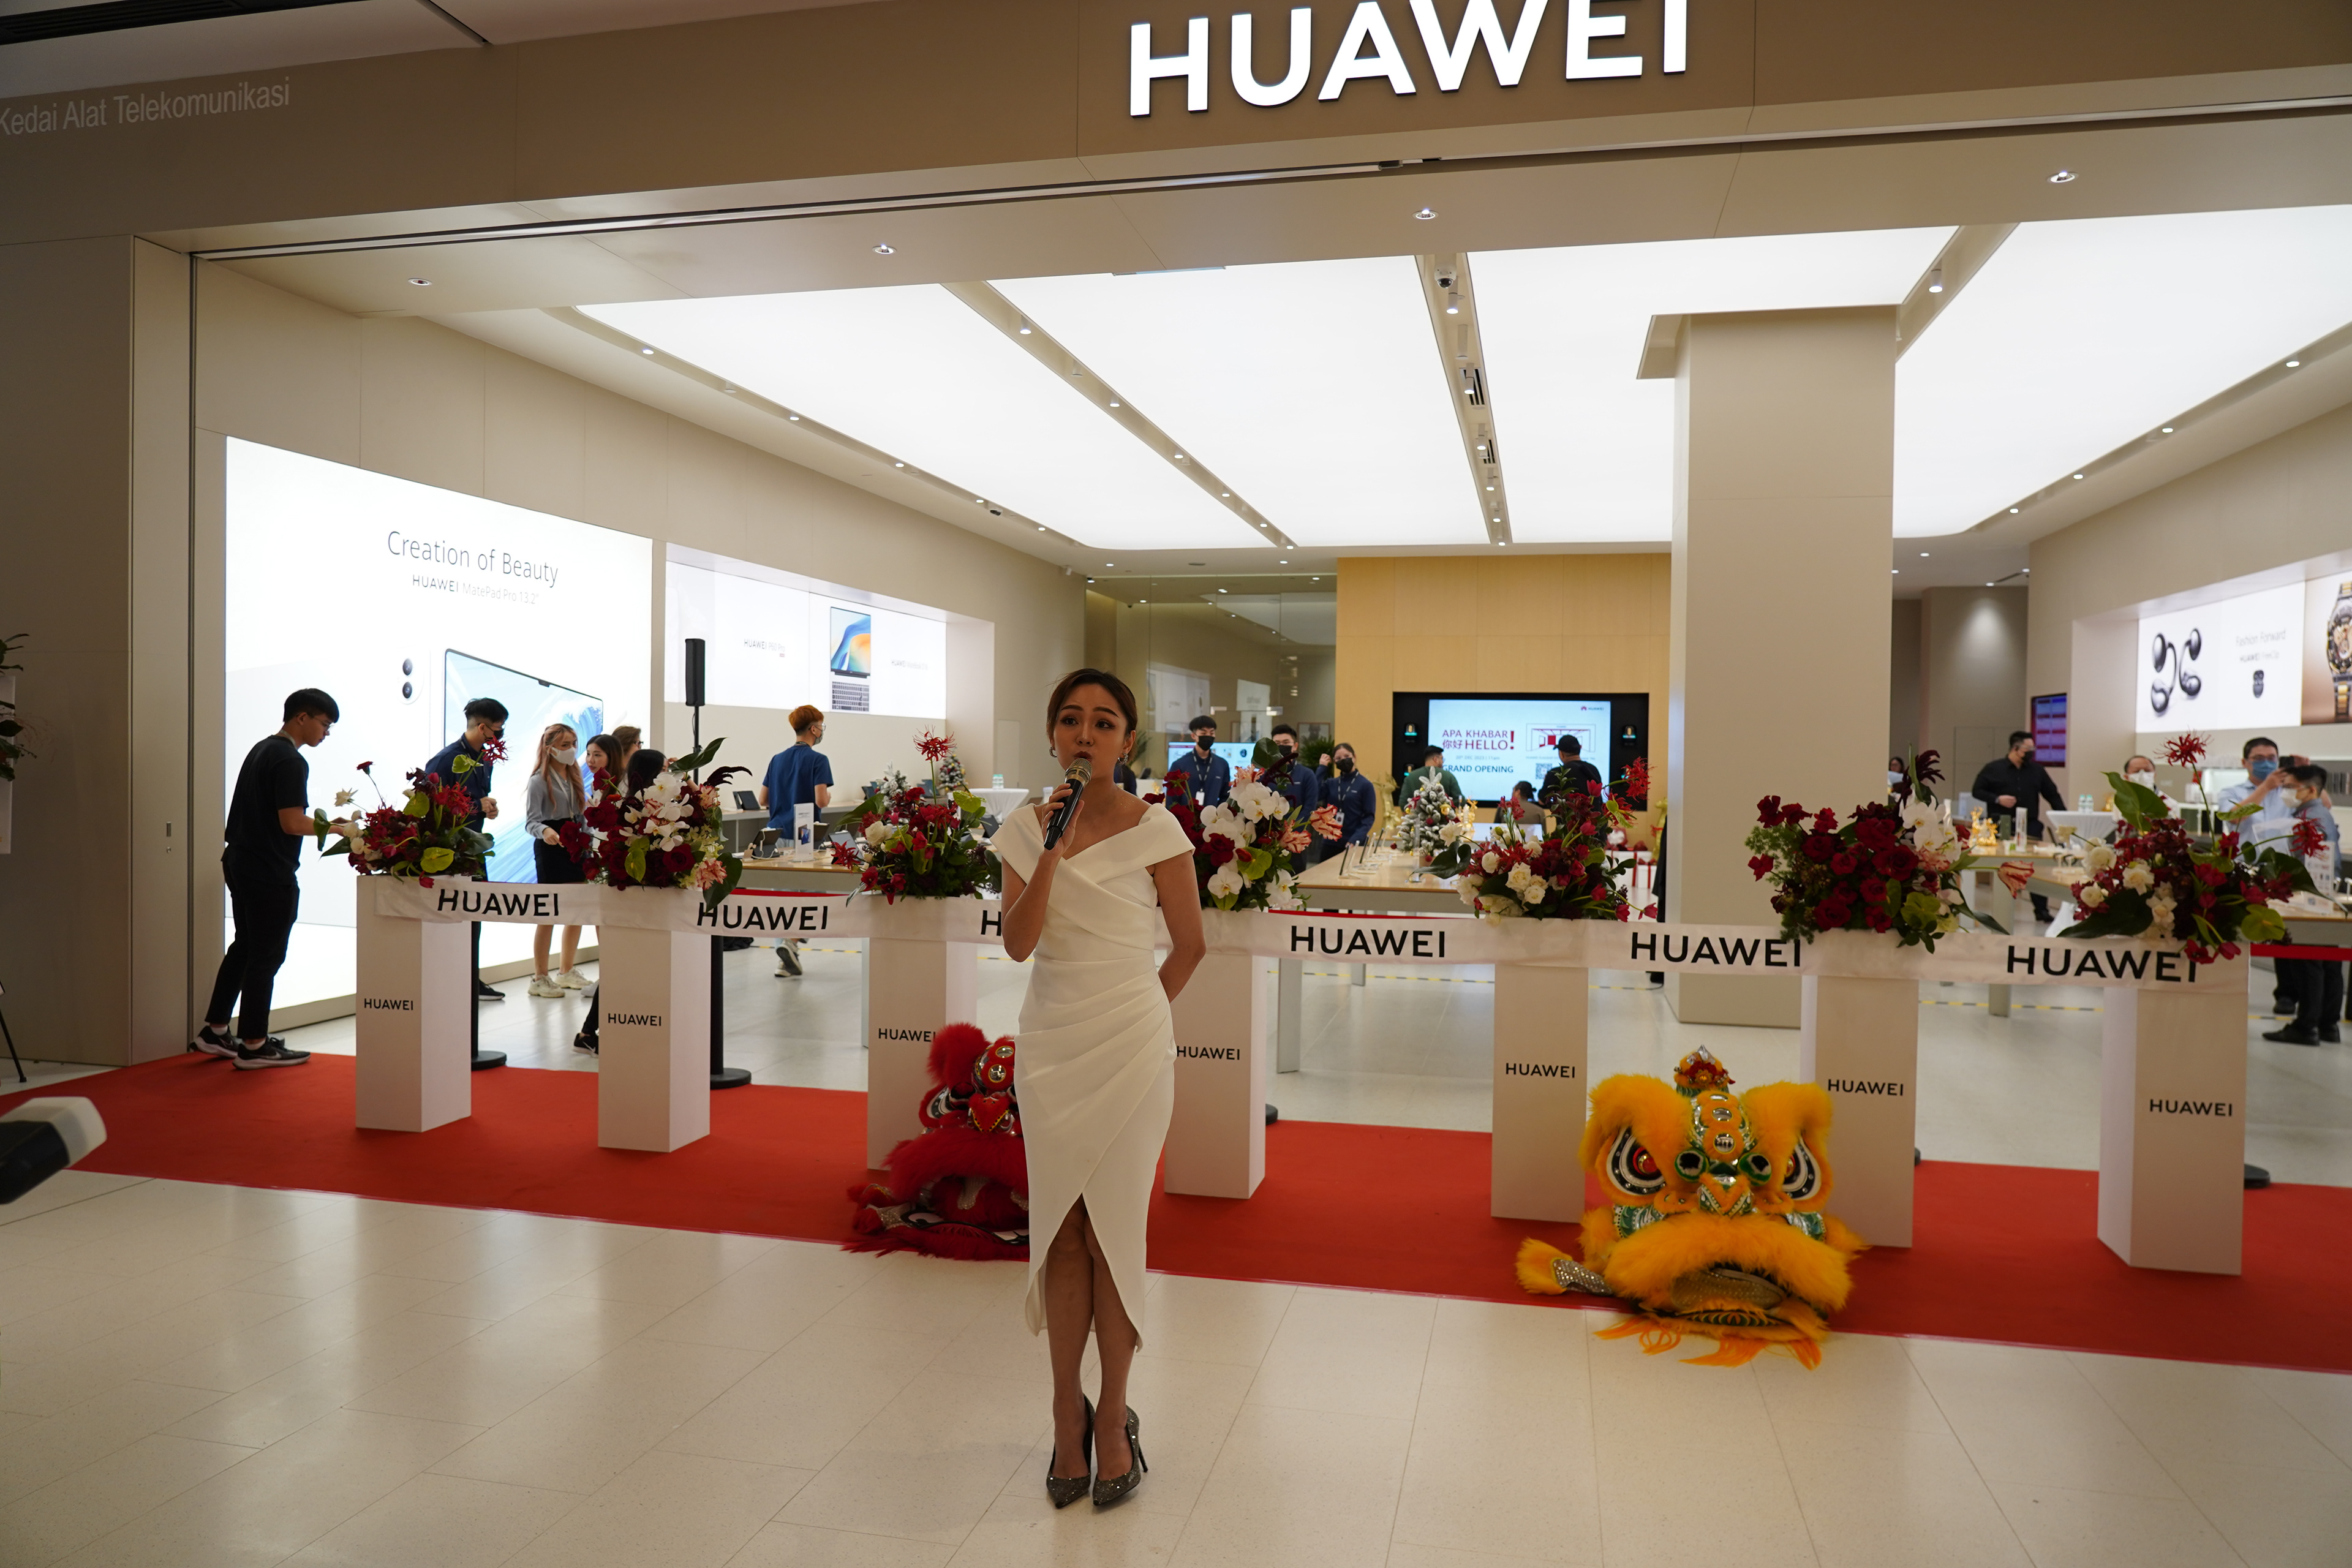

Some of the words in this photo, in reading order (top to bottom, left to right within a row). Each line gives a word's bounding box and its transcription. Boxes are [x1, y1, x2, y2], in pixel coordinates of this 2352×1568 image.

[1130, 0, 1687, 116] HUAWEI
[62, 99, 107, 130] Alat
[113, 76, 290, 124] Telekomunikasi
[388, 531, 470, 567] Creation
[478, 549, 496, 571] of
[502, 552, 559, 588] Beauty
[412, 575, 459, 593] HUAWEI
[462, 582, 501, 600] MatePad
[503, 589, 517, 602] Pro
[744, 638, 767, 649] HUAWEI
[1466, 730, 1508, 739] KHABAR
[1442, 739, 1463, 750] 你好
[437, 888, 559, 916] HUAWEI
[697, 902, 828, 930] HUAWEI
[1291, 925, 1446, 958] HUAWEI
[1631, 932, 1801, 967] HUAWEI
[2007, 945, 2196, 982] HUAWEI
[364, 998, 414, 1011] HUAWEI
[608, 1013, 662, 1027] HUAWEI
[878, 1028, 935, 1042] HUAWEI
[1177, 1046, 1240, 1060] HUAWEI
[1506, 1063, 1576, 1079] HUAWEI
[1828, 1079, 1904, 1096] HUAWEI
[2150, 1099, 2233, 1117] HUAWEI
